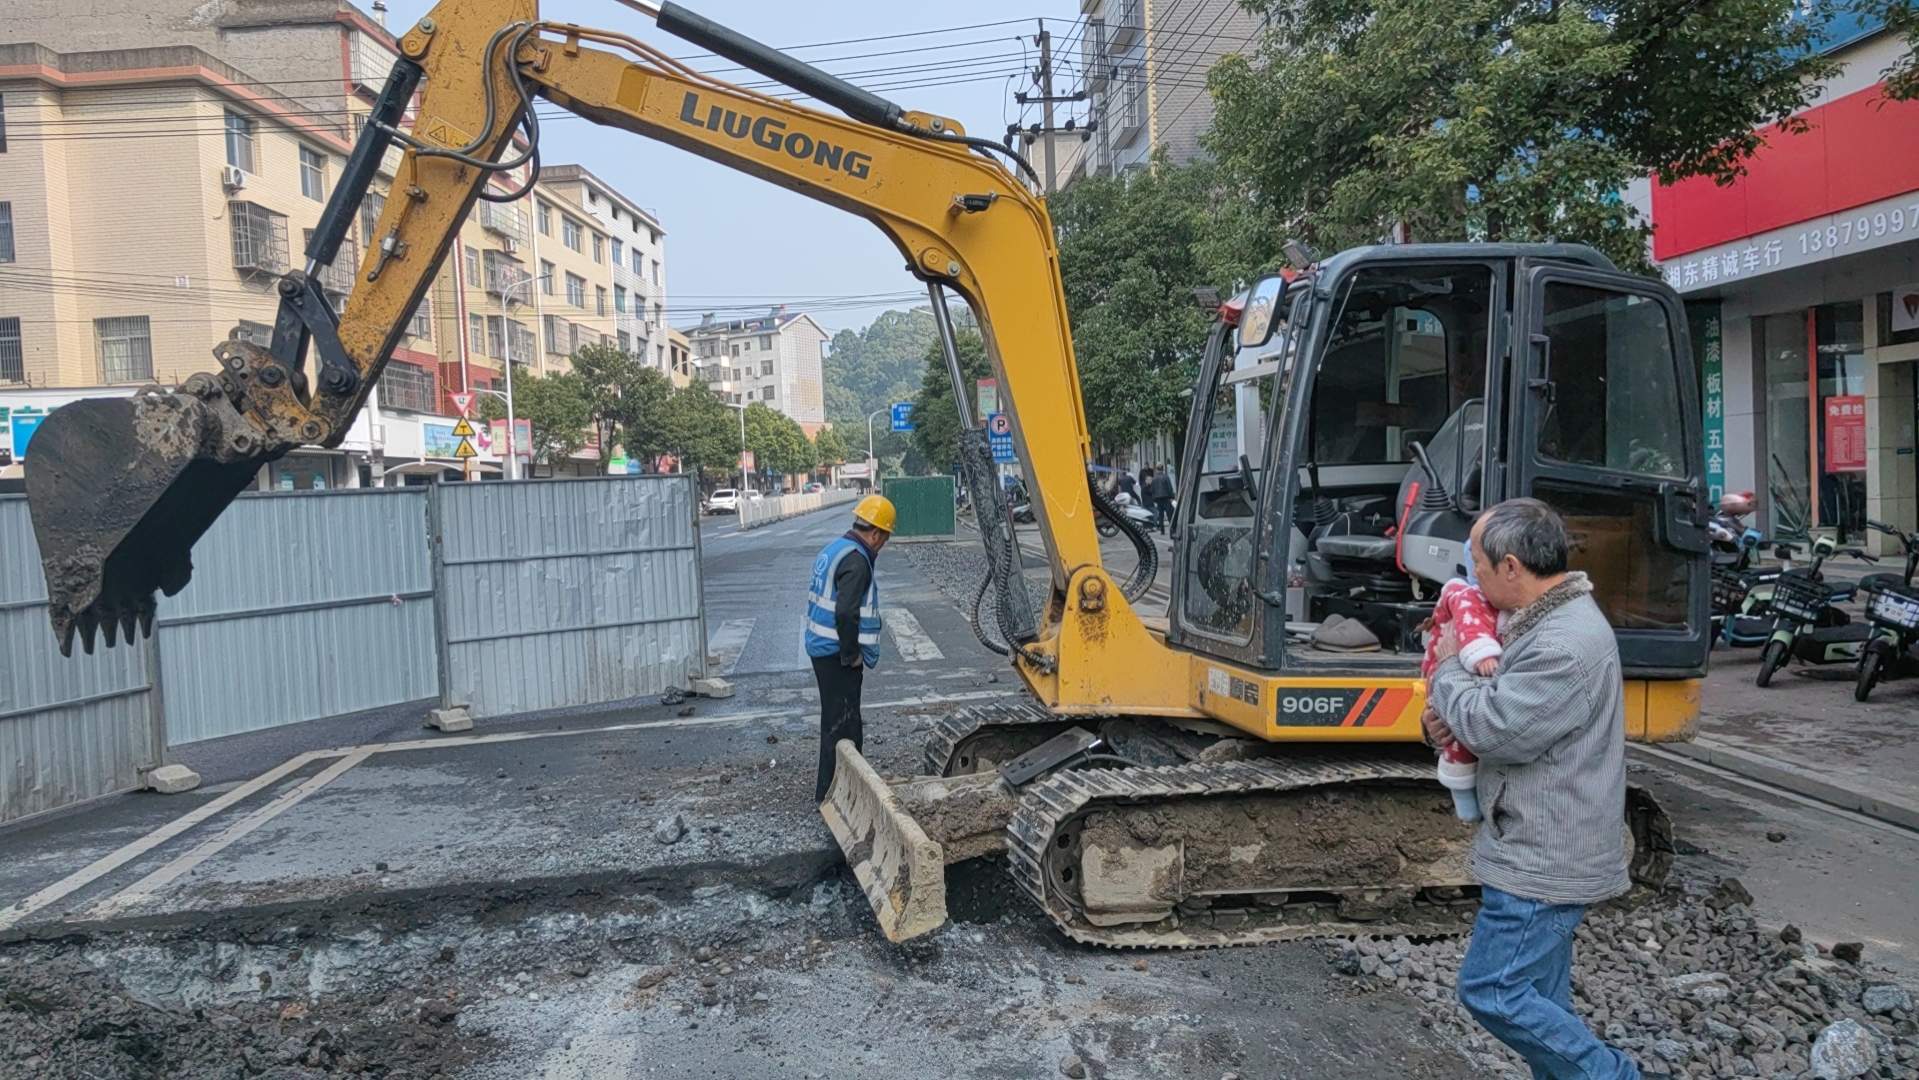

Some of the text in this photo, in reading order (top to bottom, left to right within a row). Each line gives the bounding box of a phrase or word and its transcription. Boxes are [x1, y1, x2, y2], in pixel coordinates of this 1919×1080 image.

[1666, 204, 1919, 289] 湘东精诚车行 13879997
[1707, 373, 1721, 418] 板材
[997, 419, 1006, 432] P
[1708, 430, 1723, 473] 五金
[1282, 696, 1344, 714] 906F
